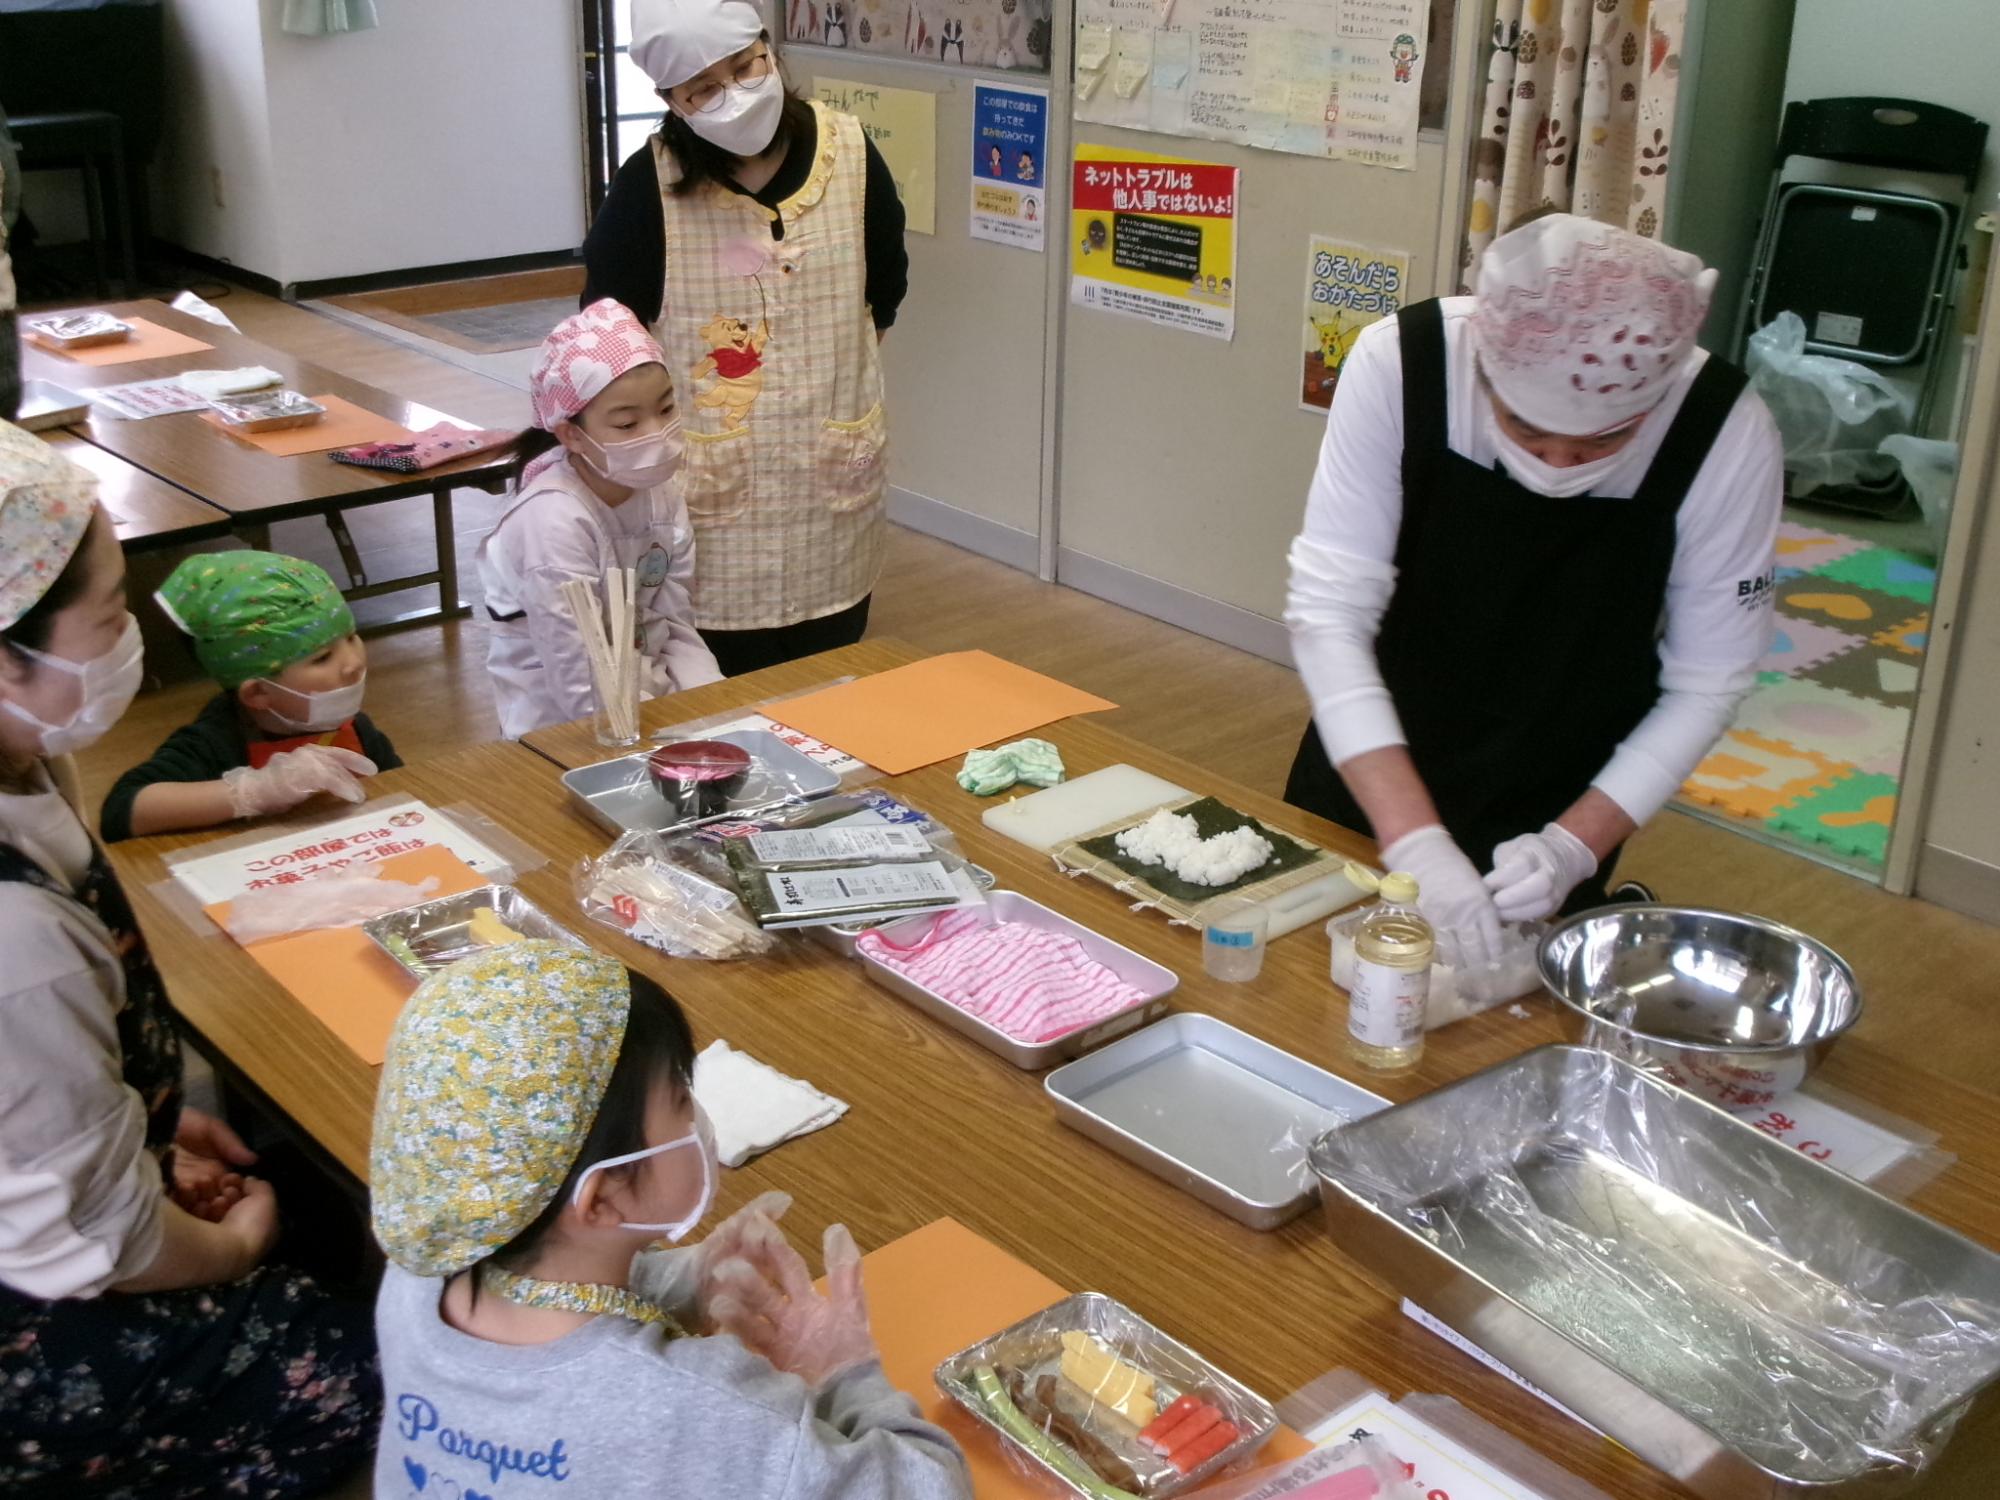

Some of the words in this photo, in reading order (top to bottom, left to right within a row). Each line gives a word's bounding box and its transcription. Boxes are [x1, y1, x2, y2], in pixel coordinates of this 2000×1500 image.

[1084, 166, 1193, 189] ネットトラブルは
[1314, 251, 1399, 293] あそんだら
[1312, 281, 1399, 316] おかたづけ
[244, 828, 394, 872] この部屋では
[397, 1393, 571, 1484] Parquet
